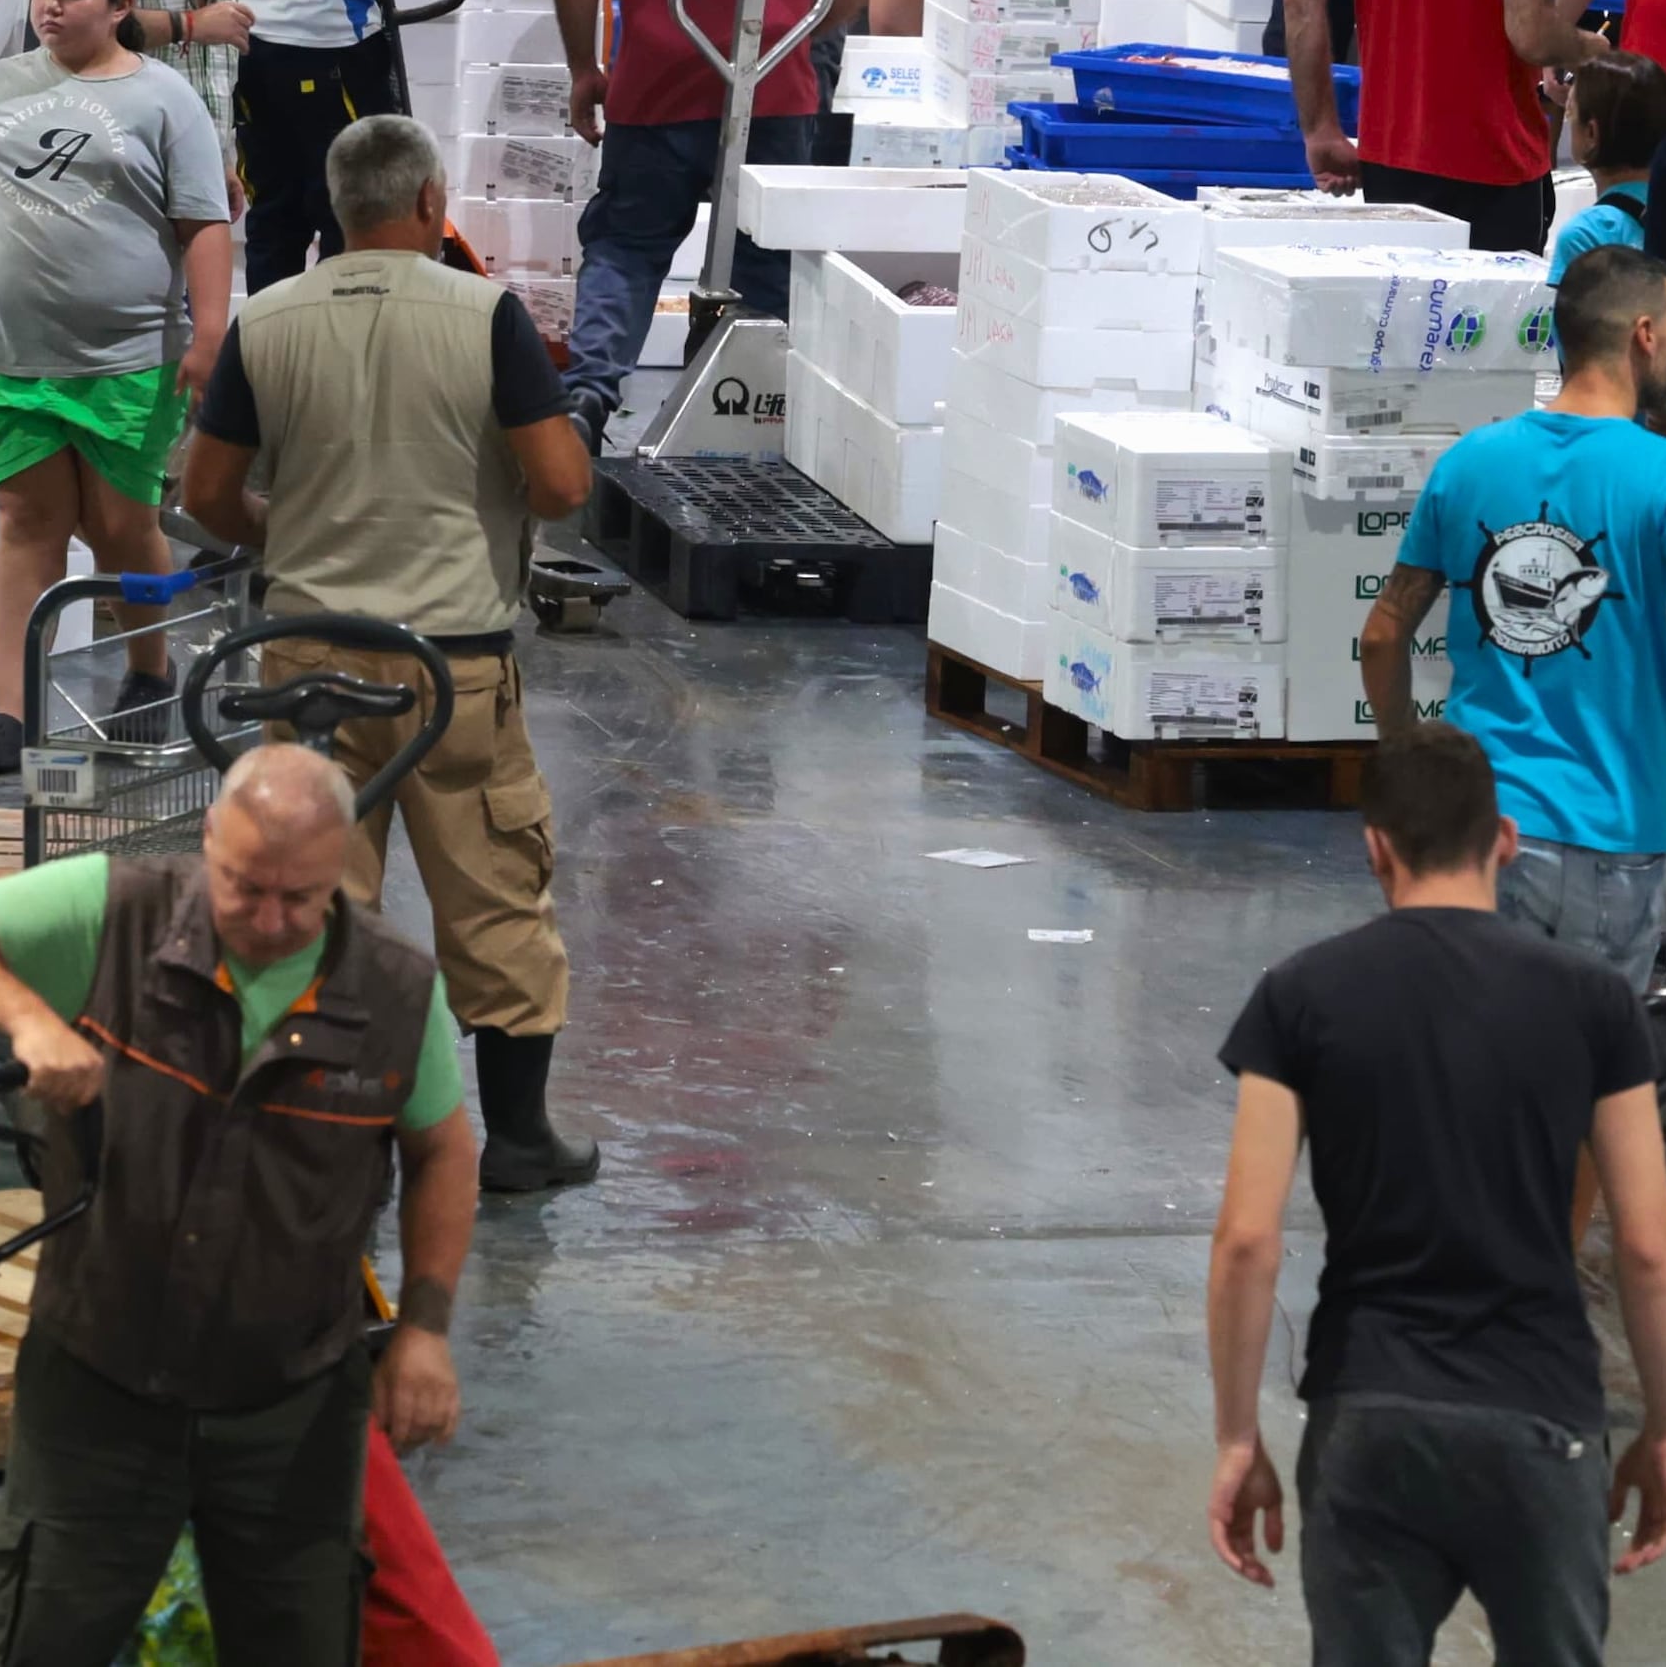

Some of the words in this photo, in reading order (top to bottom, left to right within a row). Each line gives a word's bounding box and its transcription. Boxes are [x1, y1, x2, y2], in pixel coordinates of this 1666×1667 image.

[889, 67, 921, 80] SELEC
[79, 97, 126, 155] LOYALTY
[14, 127, 94, 182] A
[1418, 278, 1447, 375] culmarex
